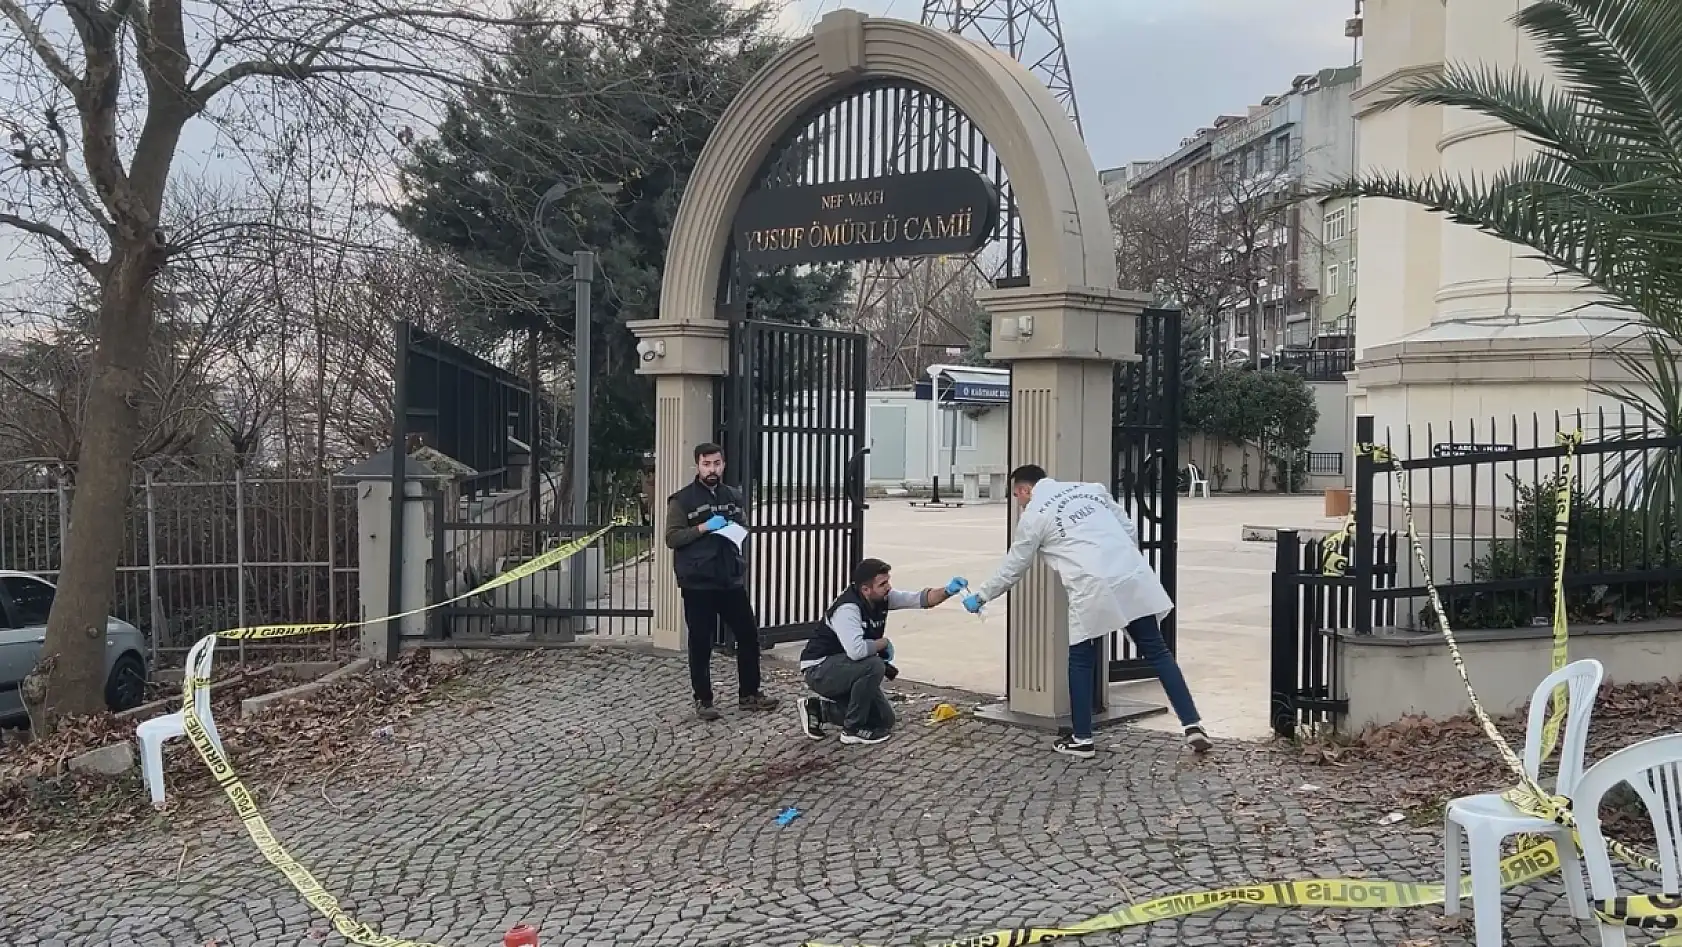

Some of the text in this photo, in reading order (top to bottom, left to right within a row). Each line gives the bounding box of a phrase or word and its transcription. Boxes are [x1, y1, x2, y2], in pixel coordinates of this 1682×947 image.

[821, 188, 885, 210] NEF VAKFI
[744, 227, 804, 253] YUSUF
[808, 214, 899, 248] ÖMÜRLÜ
